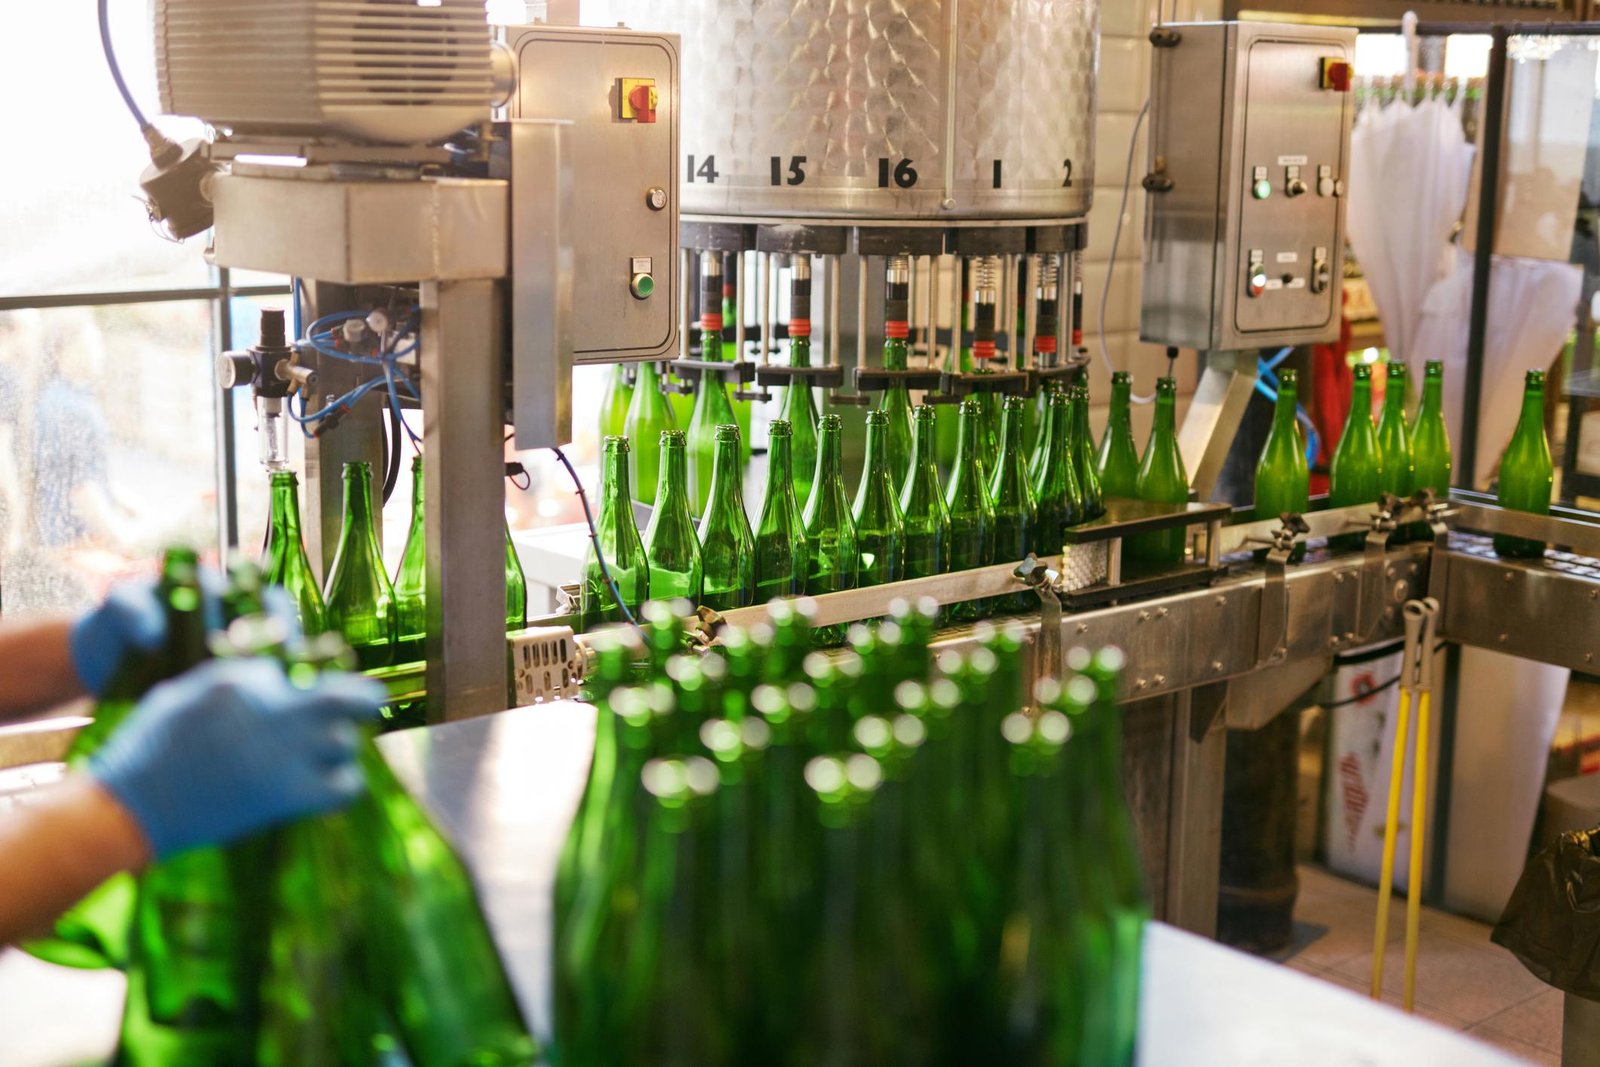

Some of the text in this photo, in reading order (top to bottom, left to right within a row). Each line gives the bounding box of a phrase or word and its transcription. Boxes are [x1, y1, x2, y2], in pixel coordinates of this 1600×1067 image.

[687, 155, 719, 183] 14
[770, 155, 807, 187] 15
[878, 157, 918, 189] 16
[992, 159, 1002, 189] 1
[1062, 158, 1073, 188] 2
